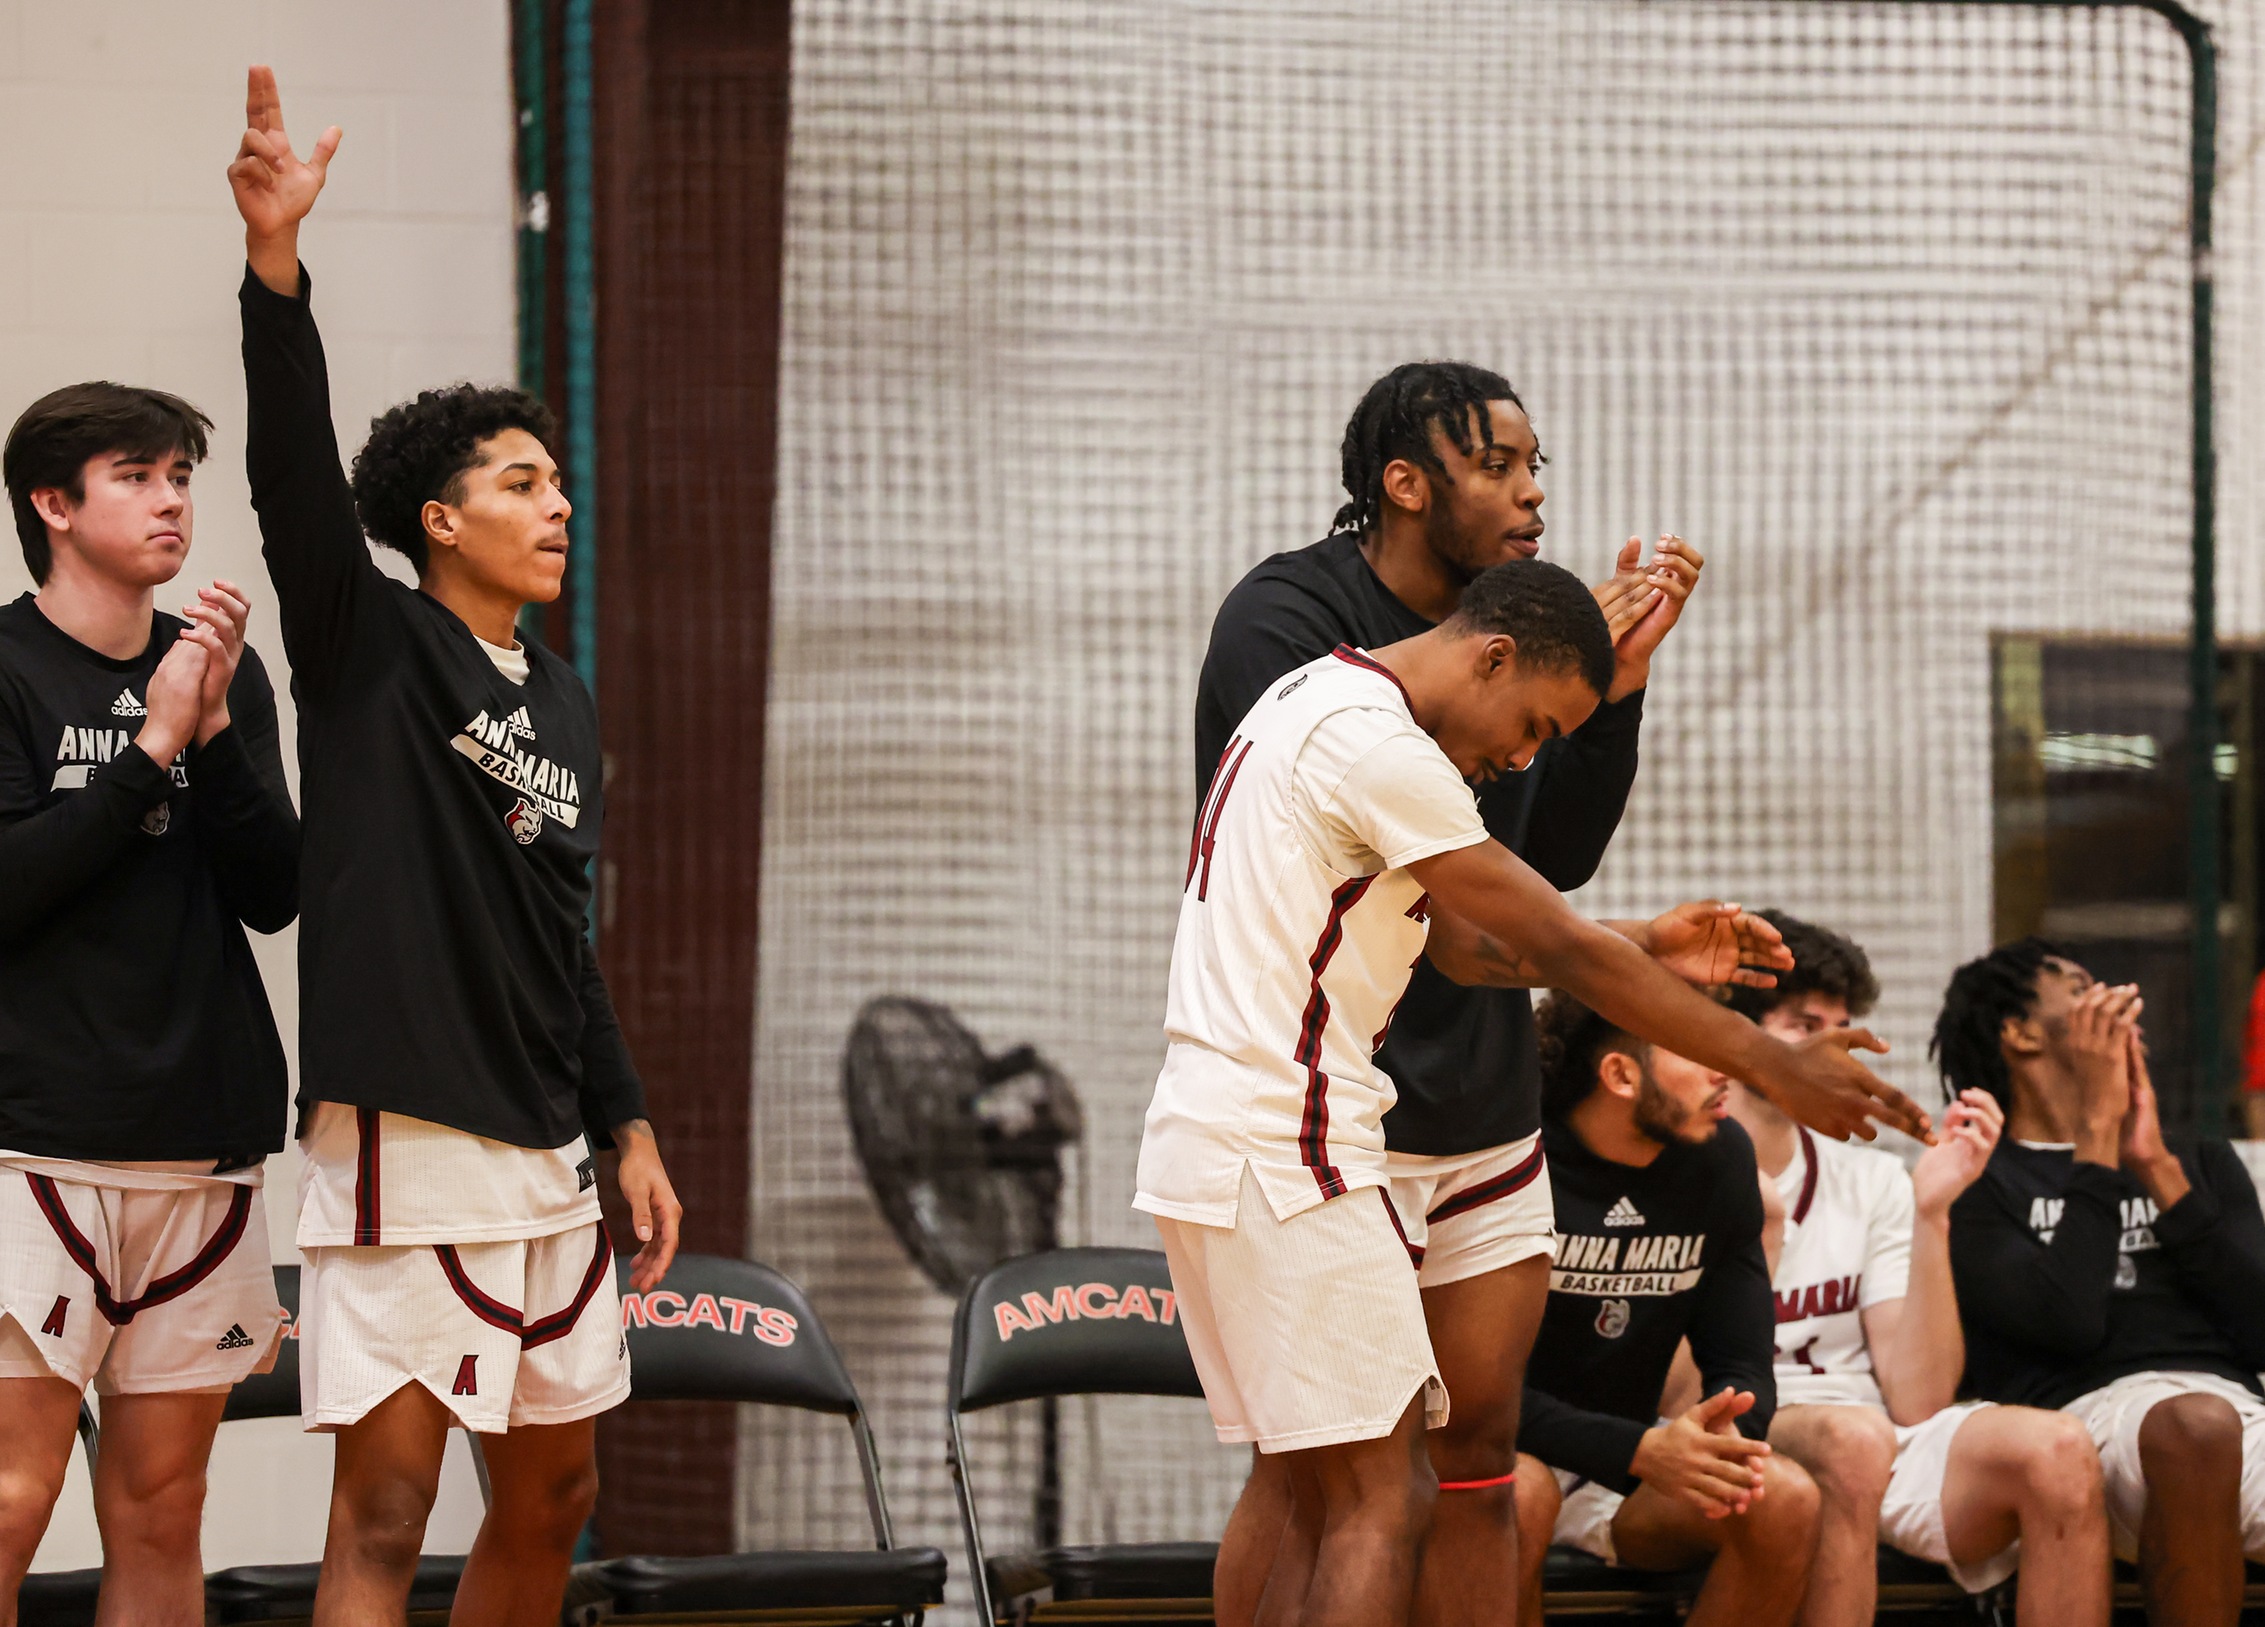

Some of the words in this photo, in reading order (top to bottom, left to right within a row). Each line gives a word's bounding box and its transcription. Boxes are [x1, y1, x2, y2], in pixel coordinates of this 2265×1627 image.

[111, 706, 148, 717] adidas
[508, 722, 536, 741] adidas
[515, 748, 580, 805] MARIA
[1184, 734, 1255, 903] 14
[1560, 1274, 1676, 1293] BASKETBALL
[622, 1291, 798, 1348] MCATS
[993, 1282, 1178, 1342] AMCAT
[216, 1336, 254, 1351] adidas
